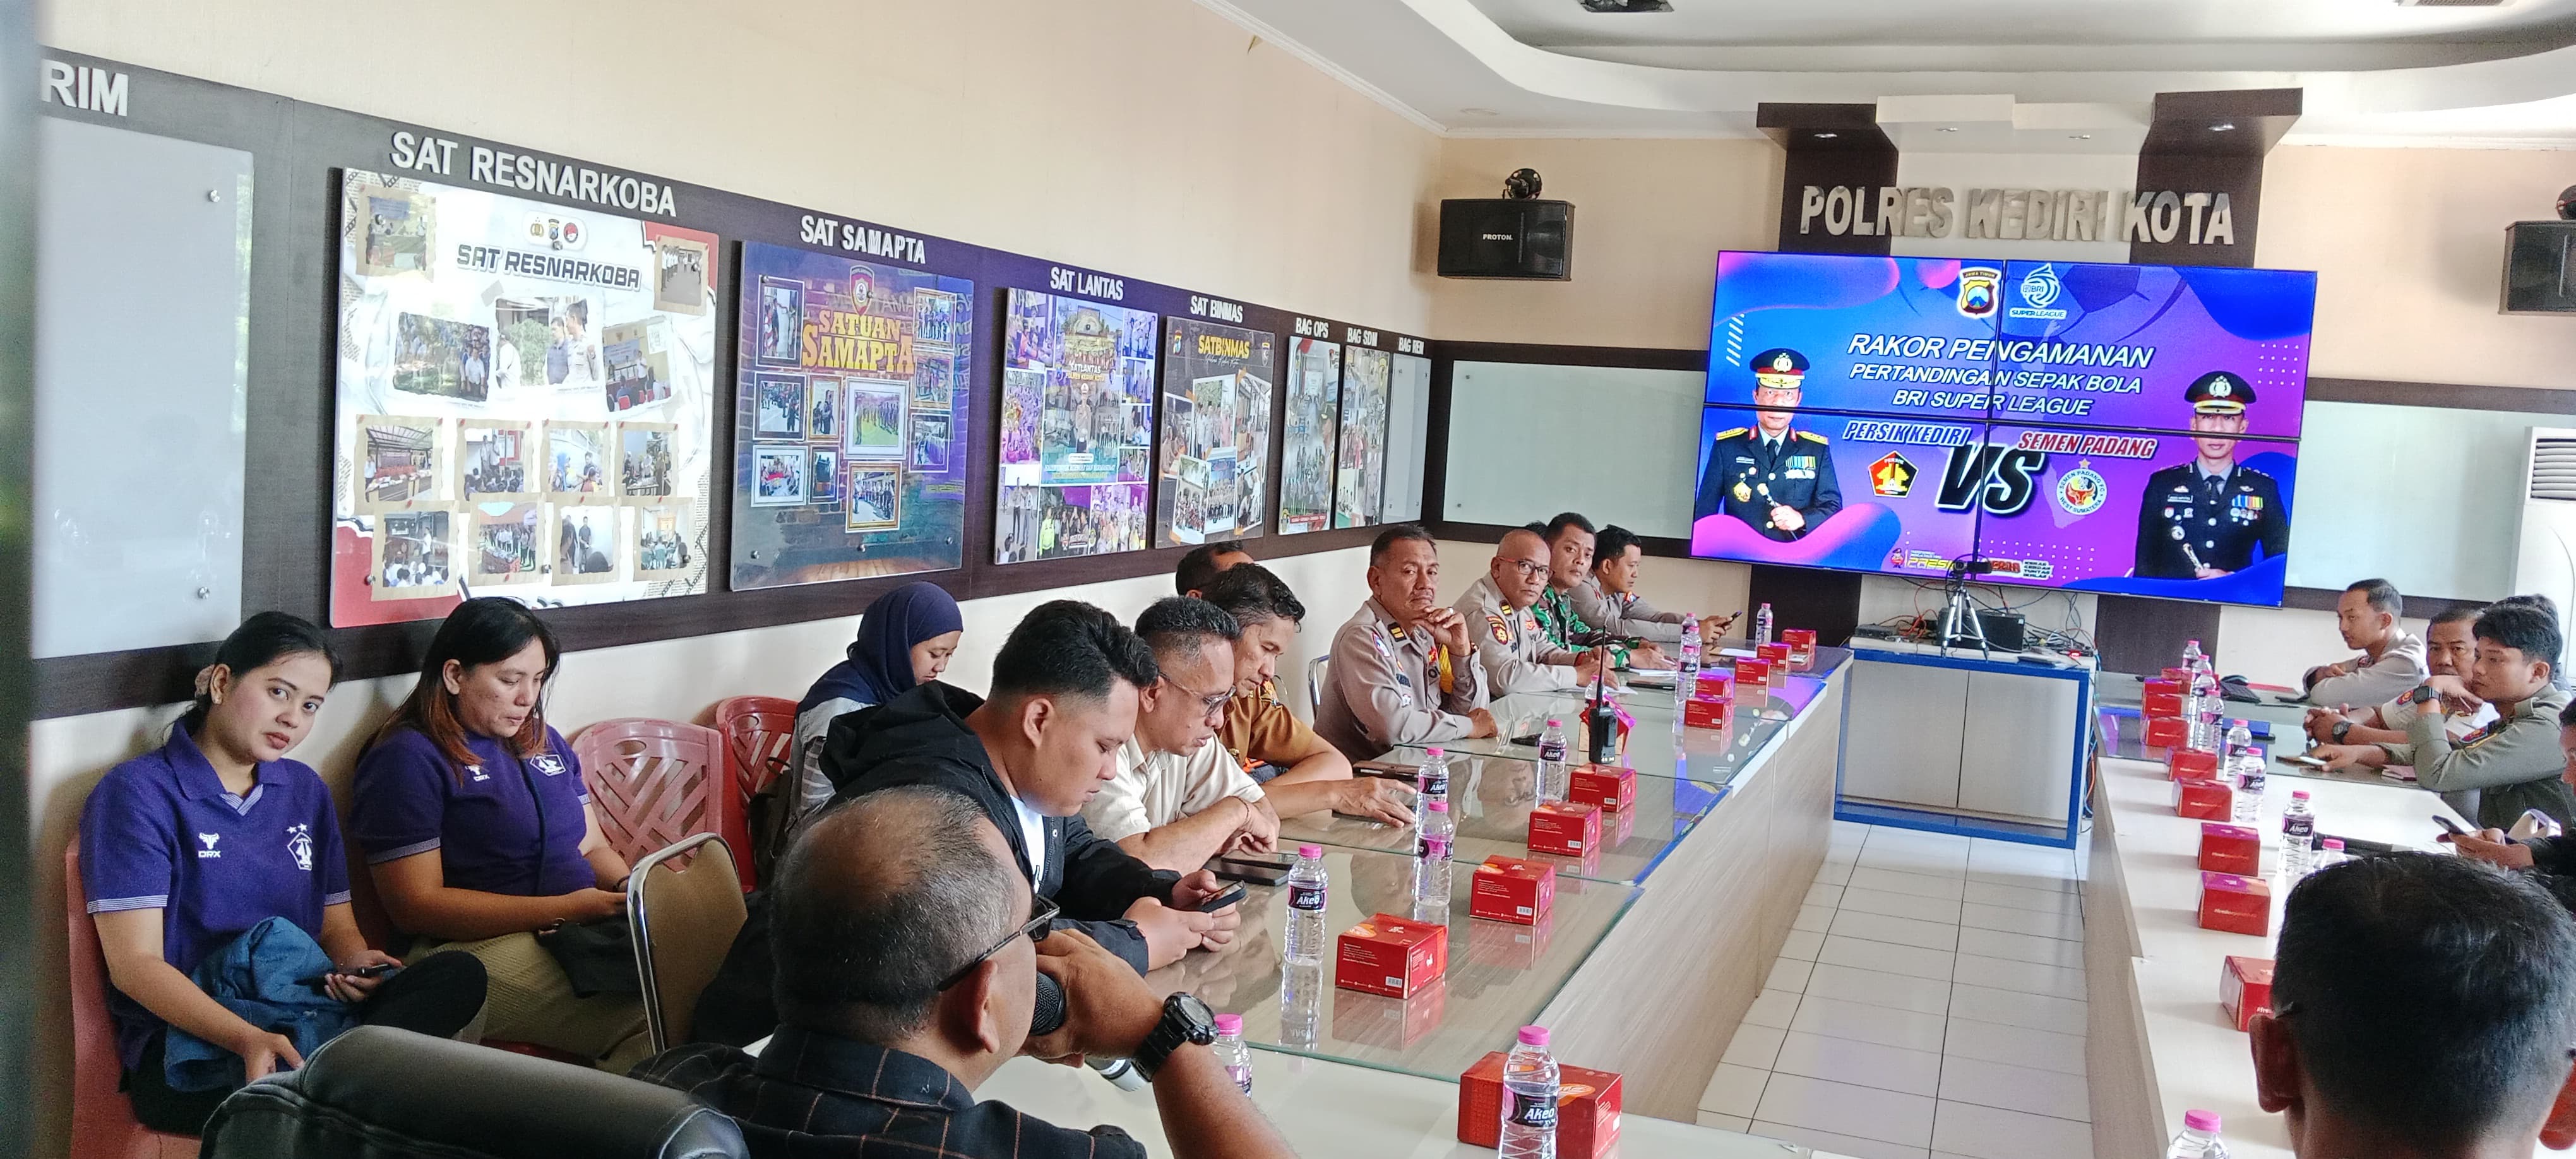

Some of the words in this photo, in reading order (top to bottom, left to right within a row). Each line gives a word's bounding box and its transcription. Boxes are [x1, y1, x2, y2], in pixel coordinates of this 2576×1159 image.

[390, 131, 458, 175] SAT
[471, 146, 677, 218] RESNARKOBA
[1800, 186, 1954, 239] POLRES
[1965, 187, 2110, 242] KEDIRI
[2122, 190, 2235, 246] KOTA
[799, 215, 838, 246] SAT
[842, 224, 926, 264] SAMAPTA
[457, 244, 501, 270] SAT
[504, 250, 641, 291] RESNARKOBA
[1050, 266, 1075, 291] SAT
[1077, 273, 1124, 301] LANTAS
[1190, 295, 1208, 316] SAT
[1210, 299, 1244, 323] BINMAS
[819, 310, 900, 342] SATUAN
[1296, 318, 1312, 336] BAG
[1313, 321, 1329, 339] OPS
[1347, 327, 1361, 344] BAG
[1363, 330, 1378, 347] SDM
[802, 324, 915, 375] SAMAPTA
[1198, 335, 1250, 360] SATBINMAS
[1398, 337, 1411, 353] BAG
[1412, 340, 1424, 355] REN
[1848, 334, 1945, 359] RAKOR
[1948, 338, 2155, 368] PENGAMANAN
[1070, 363, 1101, 374] SATLANTAS
[1849, 364, 2012, 386] PERTANDINGAN
[2013, 371, 2085, 391] SEPAK
[2085, 376, 2142, 393] BOLA
[1892, 390, 1928, 406] BRI
[1930, 393, 2003, 411] SUPER
[2008, 396, 2094, 415] LEAGUE
[1844, 421, 1909, 443] PERSIK
[1909, 425, 1971, 446] KEDIRI
[2018, 432, 2086, 451] SEMEN
[2087, 436, 2157, 459] PADANG
[1935, 443, 2047, 514] VS
[2060, 472, 2076, 489] SEMEN
[2077, 470, 2101, 483] PADANG
[2099, 484, 2105, 492] FC
[2060, 496, 2073, 510] WEST
[1296, 895, 1320, 905] Akeo
[1524, 1107, 1555, 1120] Akeo
